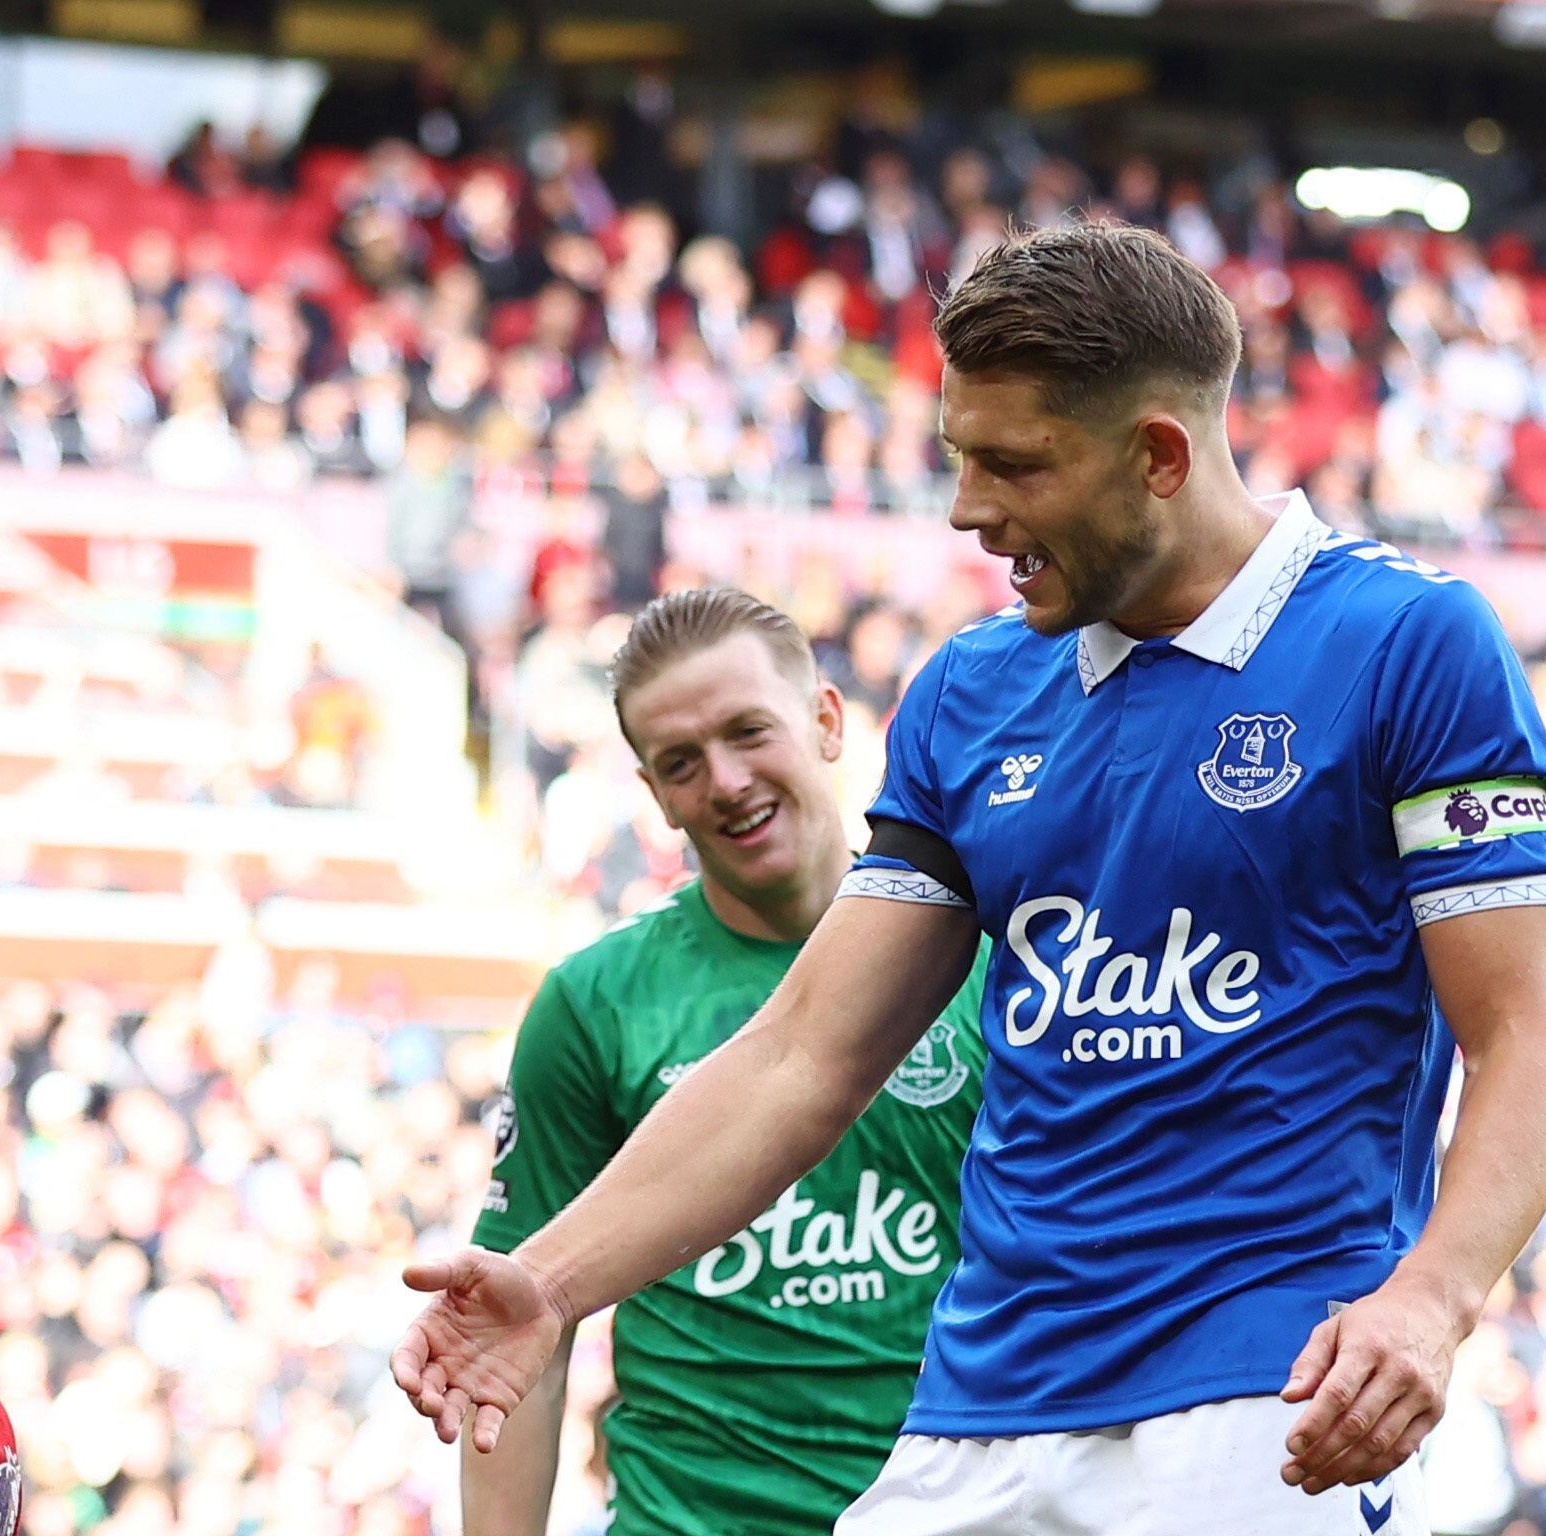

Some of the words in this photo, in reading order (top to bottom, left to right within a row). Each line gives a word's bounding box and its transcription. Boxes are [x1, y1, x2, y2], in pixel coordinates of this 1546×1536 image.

[1222, 765, 1274, 777] Everton
[988, 784, 1038, 807] hummel
[1256, 775, 1291, 802] OPTIMUM
[1006, 895, 1261, 1047] Stake
[1062, 1025, 1182, 1063] .com
[770, 1269, 885, 1309] .com
